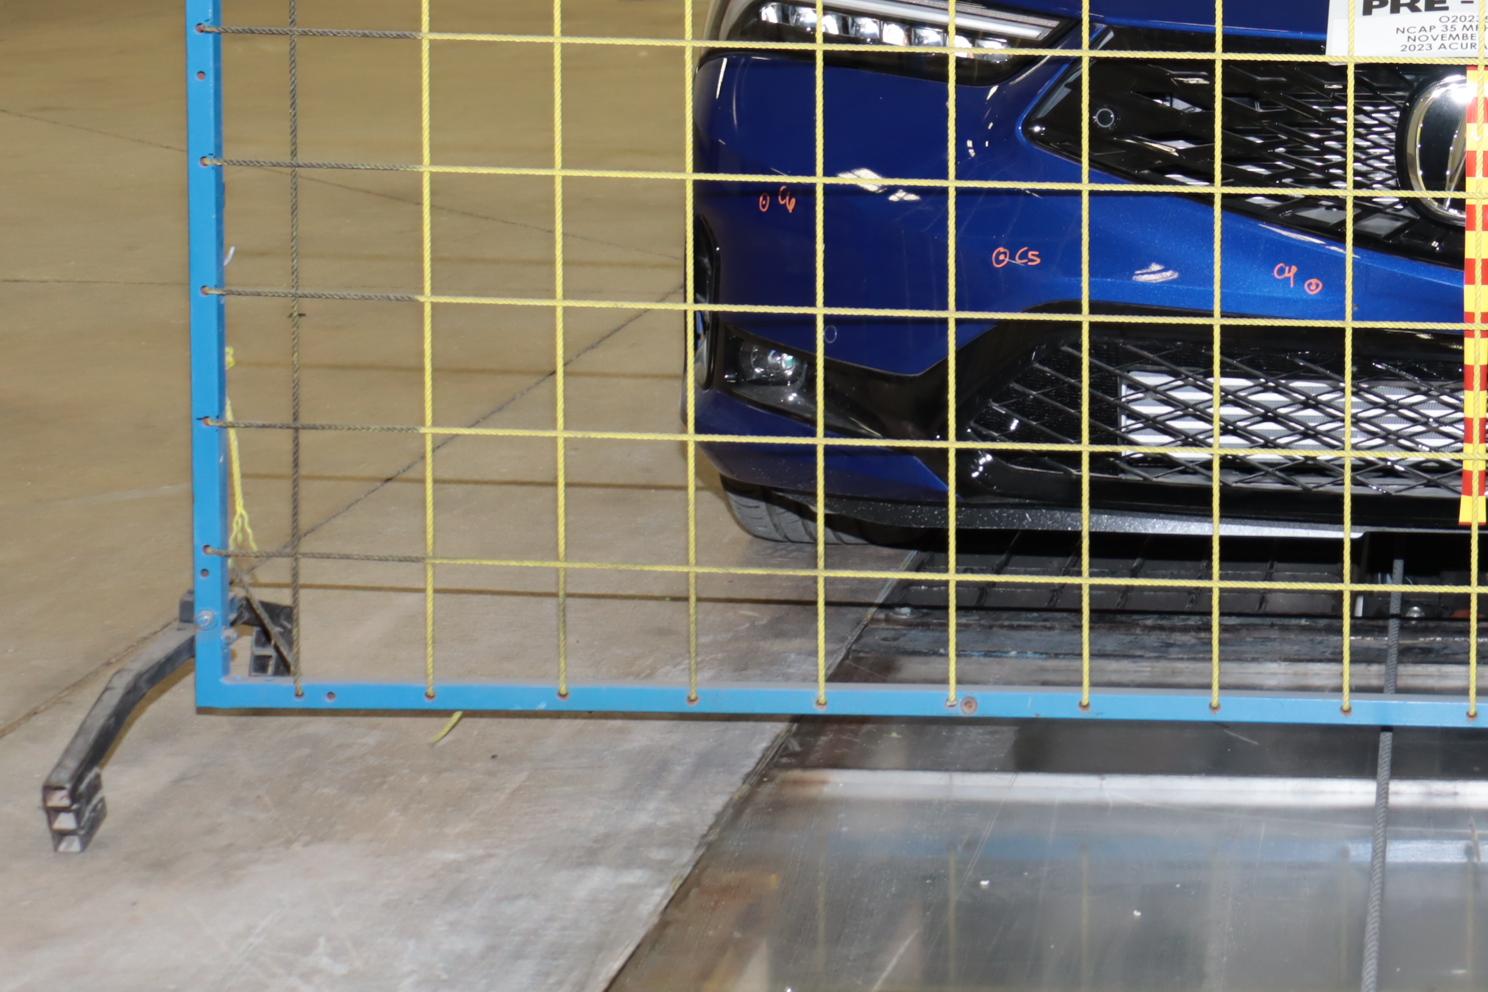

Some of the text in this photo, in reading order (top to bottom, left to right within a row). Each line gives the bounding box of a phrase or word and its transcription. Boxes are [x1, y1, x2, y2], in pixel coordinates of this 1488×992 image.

[1396, 25, 1436, 35] NCAP
[1441, 24, 1457, 33] 35
[1407, 33, 1484, 43] NOVEMBE
[1400, 43, 1433, 52] 2023
